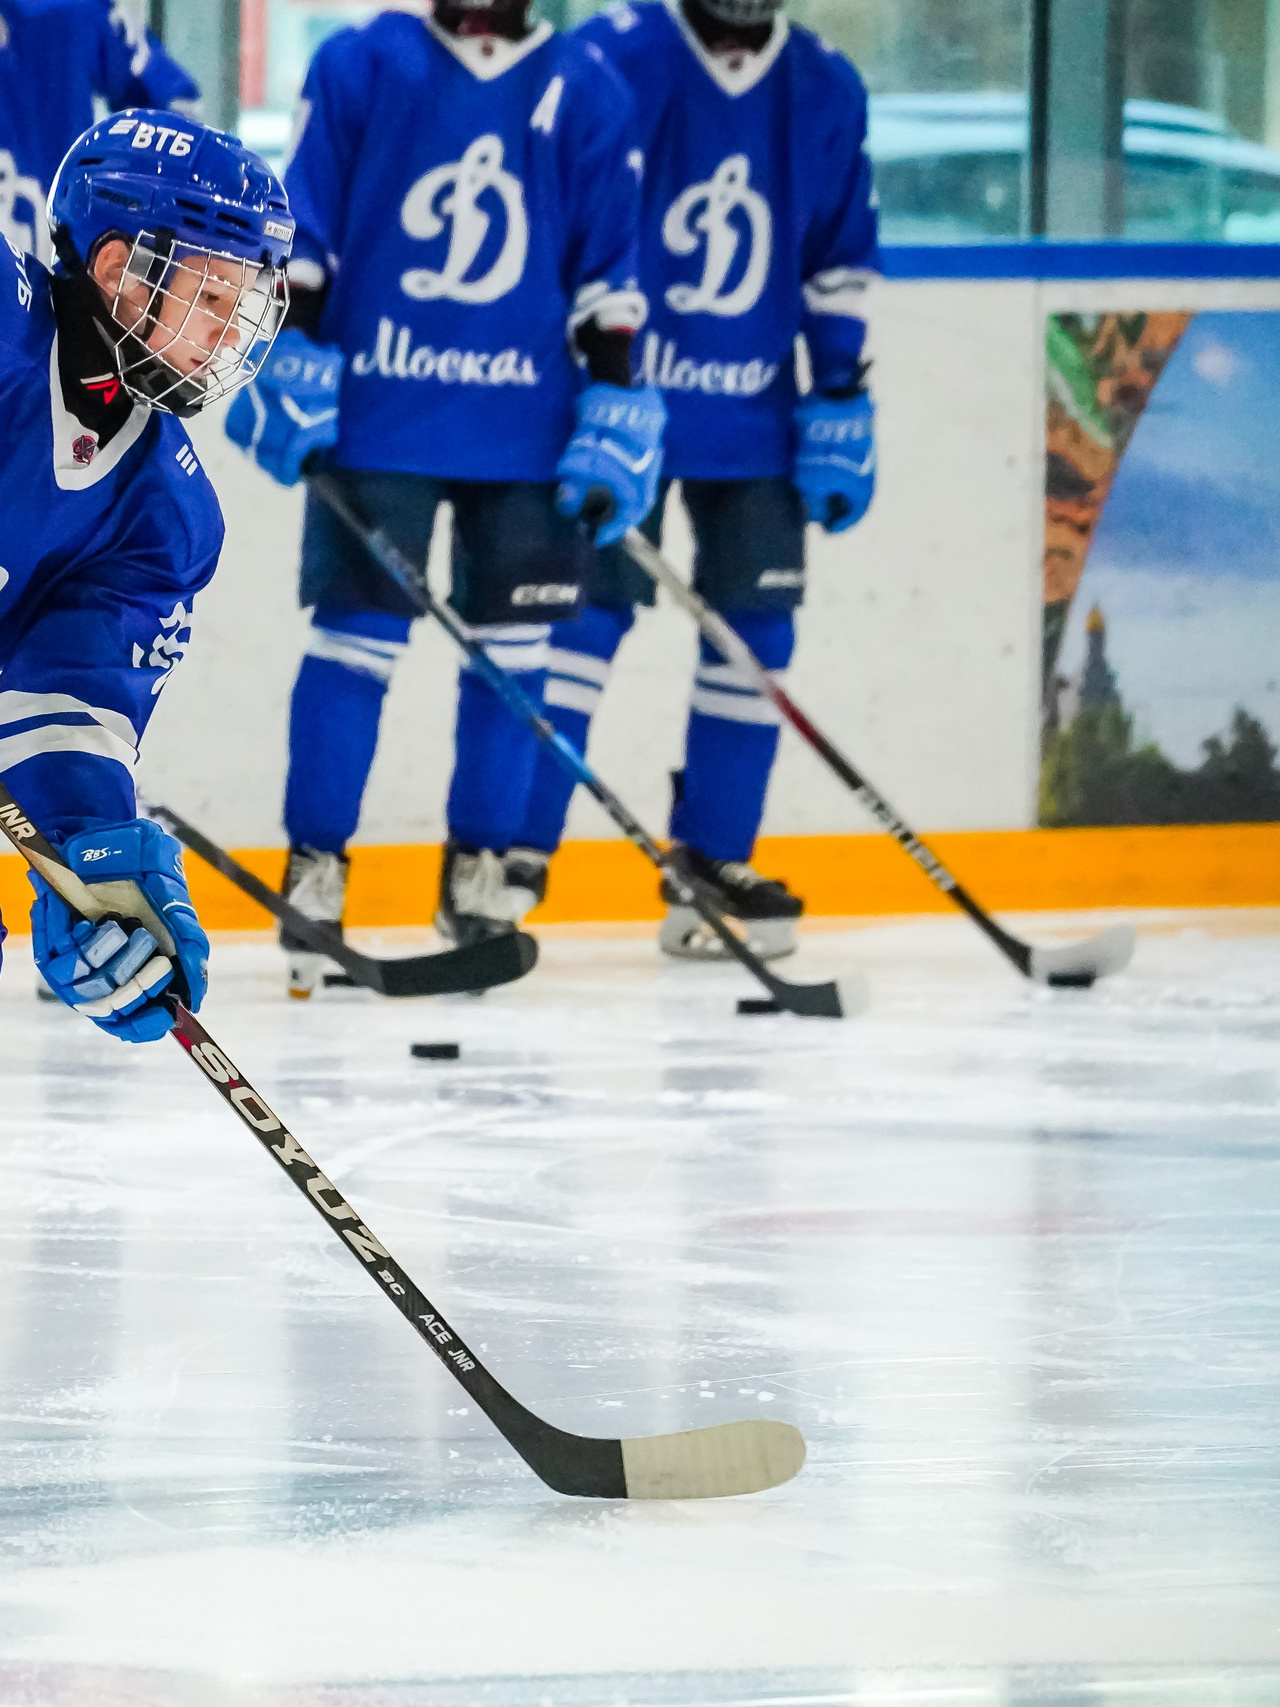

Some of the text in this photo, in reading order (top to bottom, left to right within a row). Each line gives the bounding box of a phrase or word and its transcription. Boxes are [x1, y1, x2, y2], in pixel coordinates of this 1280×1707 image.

[131, 122, 194, 156] ВТБ
[191, 1041, 476, 1372] SOYUZ BC ACE JNR
